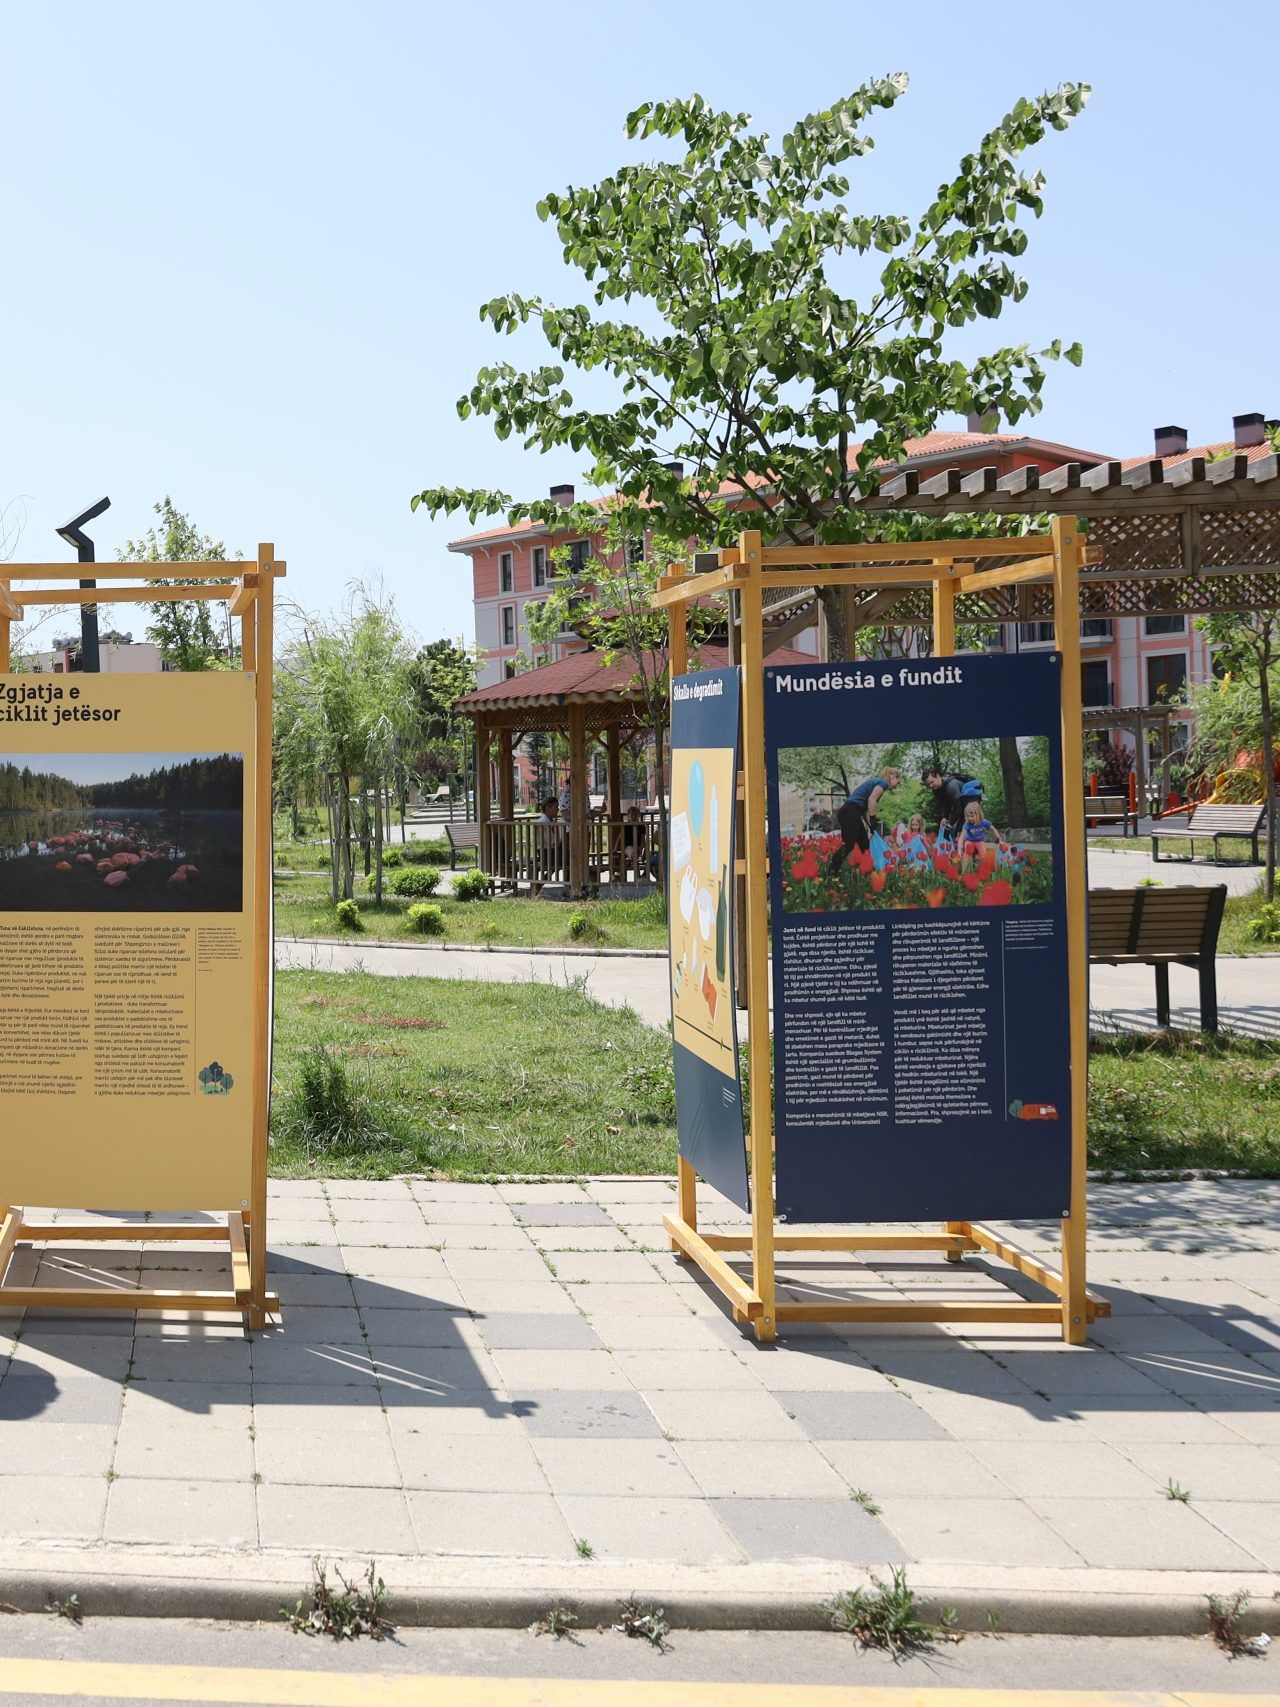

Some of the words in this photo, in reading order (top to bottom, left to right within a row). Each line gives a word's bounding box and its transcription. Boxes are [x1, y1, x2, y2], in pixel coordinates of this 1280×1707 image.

[674, 684, 689, 701] Shkalla
[694, 679, 723, 702] degradimit
[776, 671, 875, 693] Mundësia
[881, 673, 894, 688] e
[899, 666, 963, 686] fundit
[69, 687, 80, 699] e
[52, 705, 121, 726] jetësor
